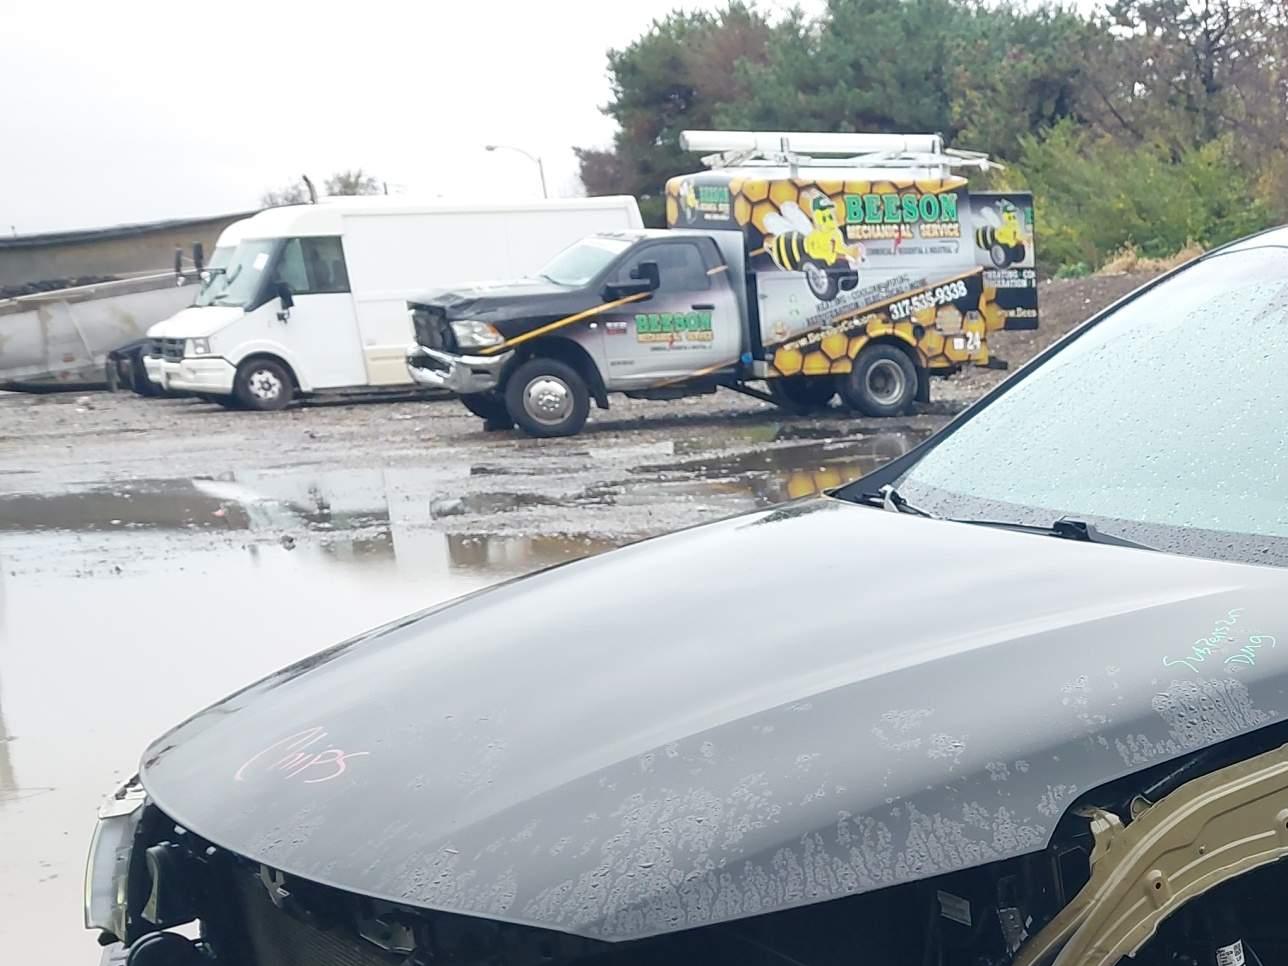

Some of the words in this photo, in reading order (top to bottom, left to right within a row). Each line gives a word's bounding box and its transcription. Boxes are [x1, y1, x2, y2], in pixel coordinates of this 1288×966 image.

[843, 193, 958, 224] BEESON
[846, 223, 914, 240] MECHANICAL
[919, 222, 961, 238] SERVICE
[888, 279, 967, 320] 317-535-9338
[634, 312, 711, 333] BEESON
[966, 331, 981, 350] 24
